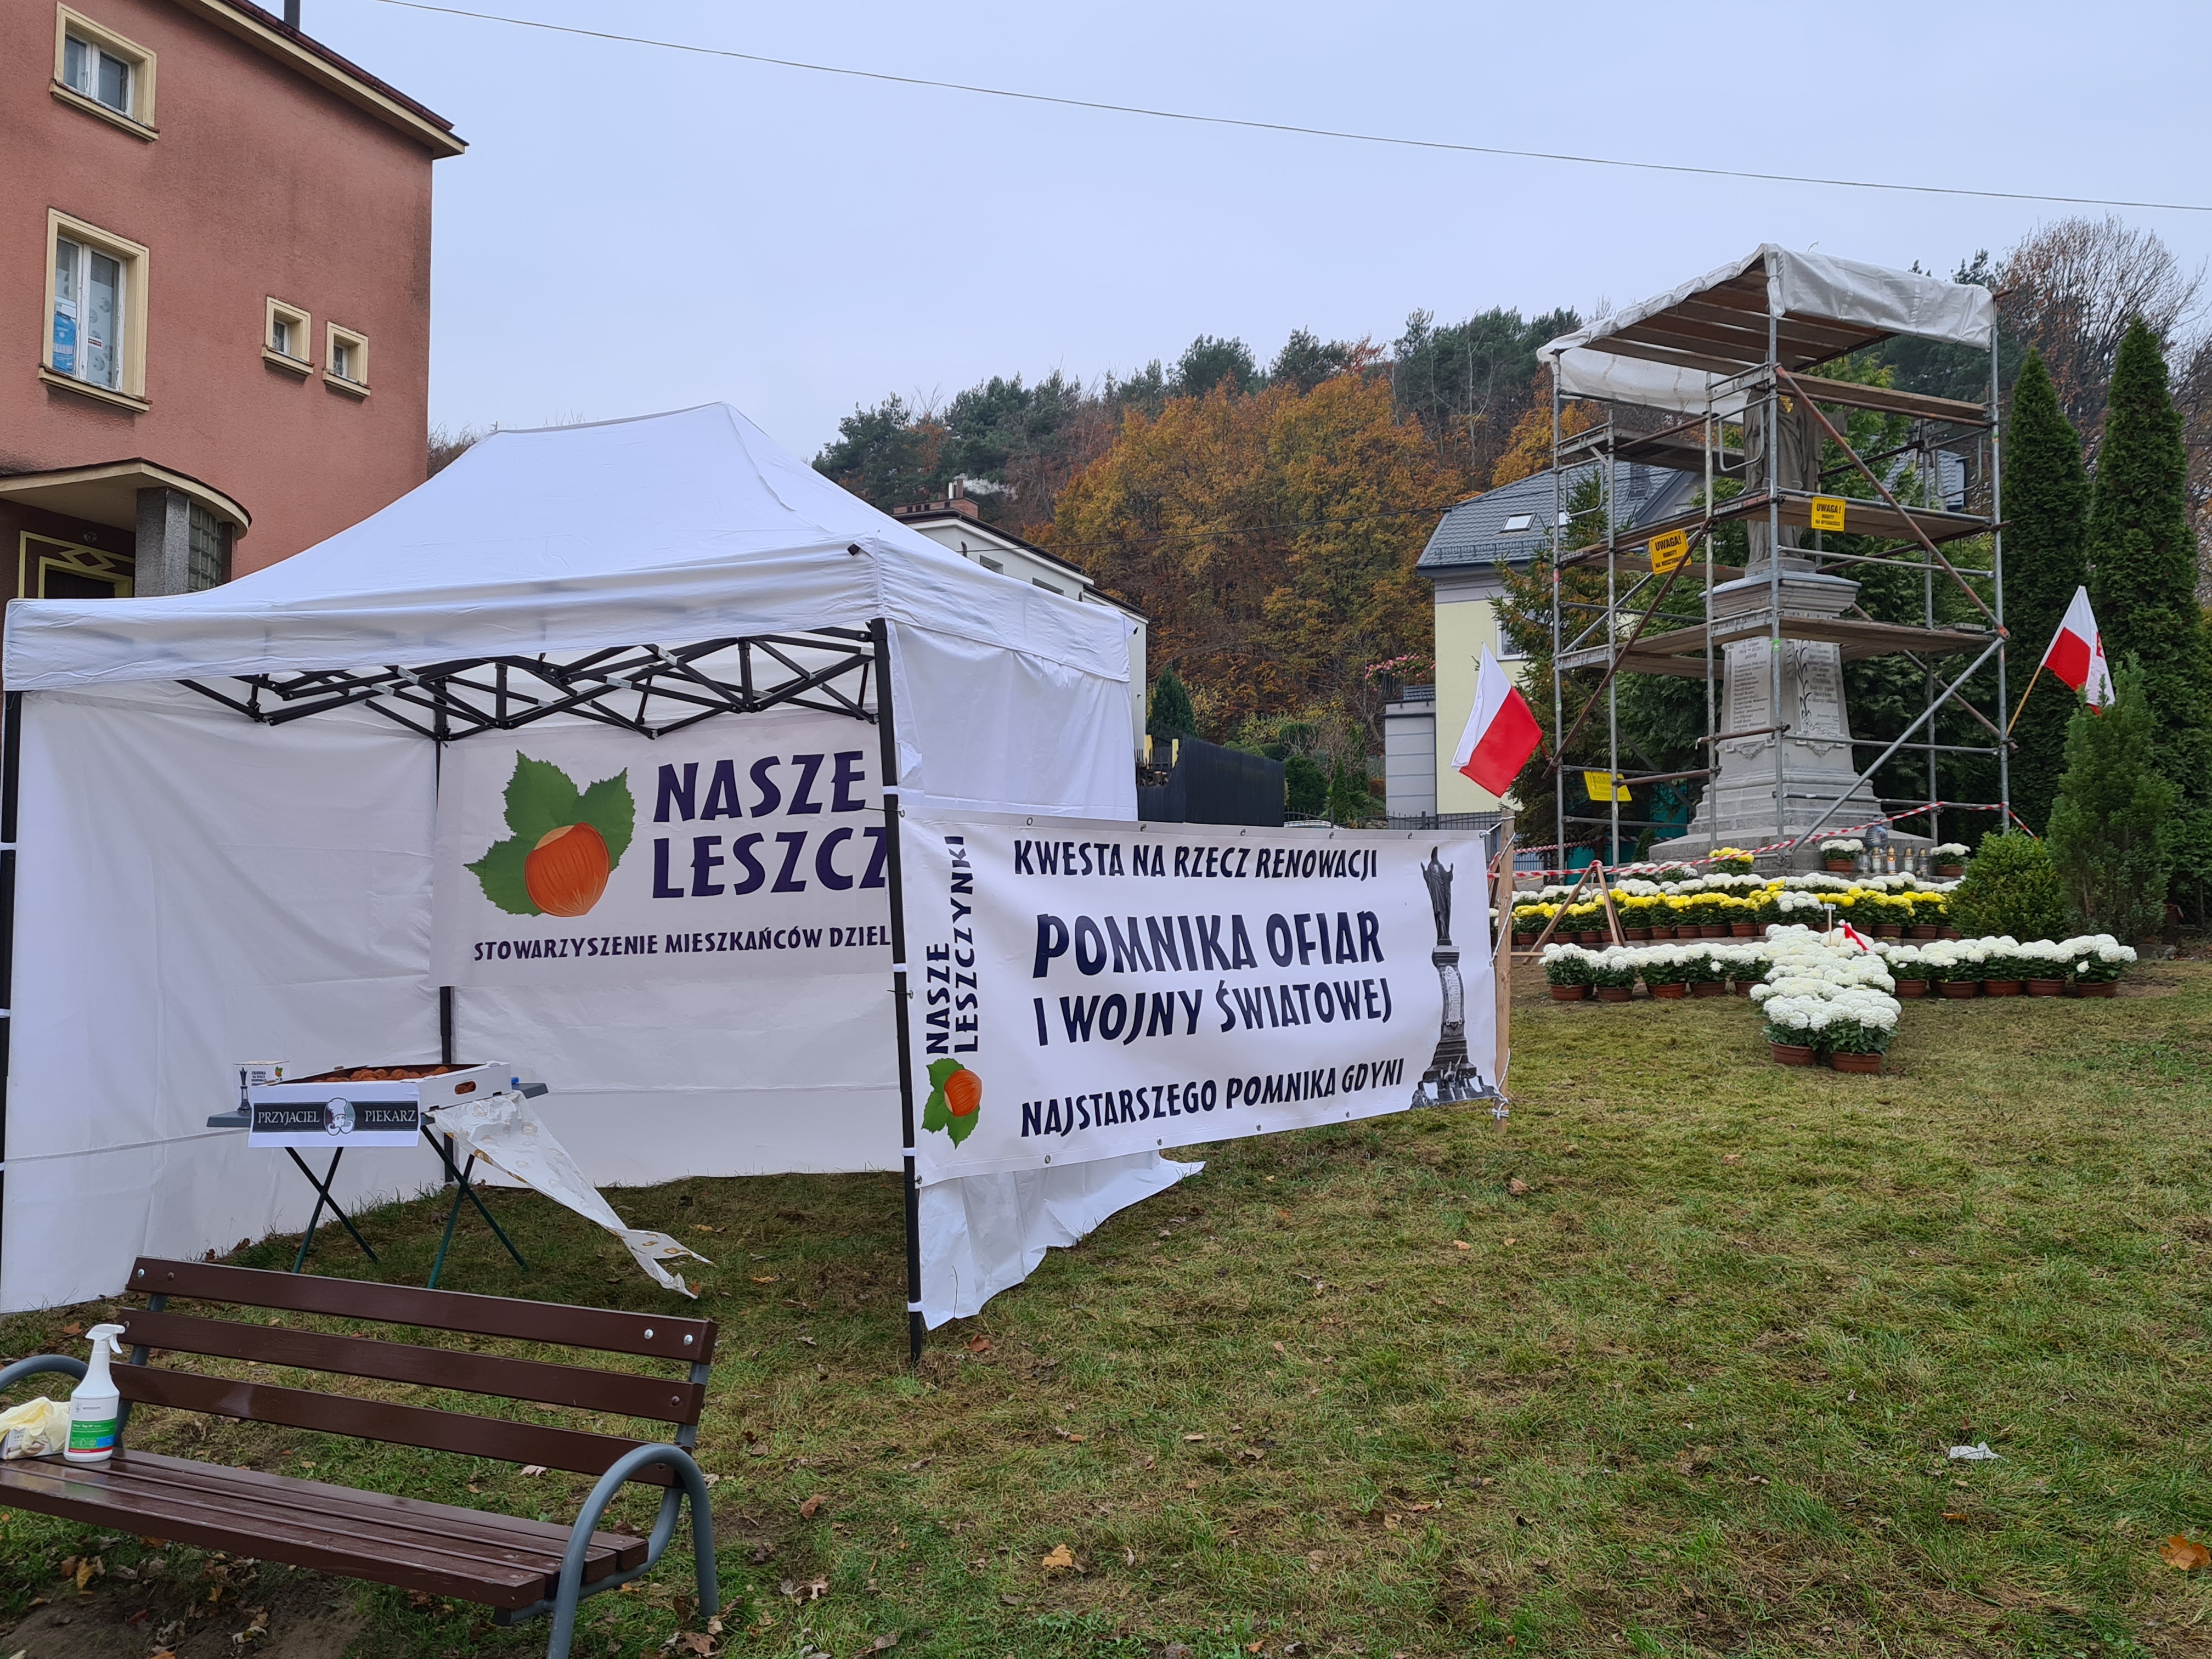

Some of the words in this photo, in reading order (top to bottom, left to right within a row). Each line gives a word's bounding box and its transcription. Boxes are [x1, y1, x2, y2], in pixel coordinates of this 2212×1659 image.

[1816, 503, 1842, 514] UWAGA!
[1655, 535, 1682, 551] UWAGA!
[653, 751, 866, 822] NASZE
[653, 827, 887, 898] LESZCZ
[1014, 840, 1125, 876] KWESTA
[1133, 845, 1165, 877] NA
[1175, 847, 1251, 877] RZECZ
[1255, 849, 1377, 882] RENOWACJI
[475, 935, 657, 961] STOWARZYSZENIE
[665, 926, 822, 953] MIESZKAŃCÓW
[830, 926, 891, 947] DZIEL
[945, 836, 978, 1054] LESZCZYNKI
[1032, 914, 1258, 978] POMNIKA
[1266, 911, 1385, 967] OFIAR
[927, 943, 950, 1054] NASZE
[1033, 997, 1048, 1046] I
[1059, 989, 1203, 1046] WOJNY
[1215, 980, 1392, 1033] ŚWIATOWEJ
[258, 1111, 320, 1125] PRZYJACIEL
[365, 1110, 416, 1122] PIEKARZ
[1021, 1080, 1217, 1137] NAJSTARSZEGO
[1226, 1068, 1336, 1109] POMNIKA
[1341, 1058, 1404, 1093] GDYNI
